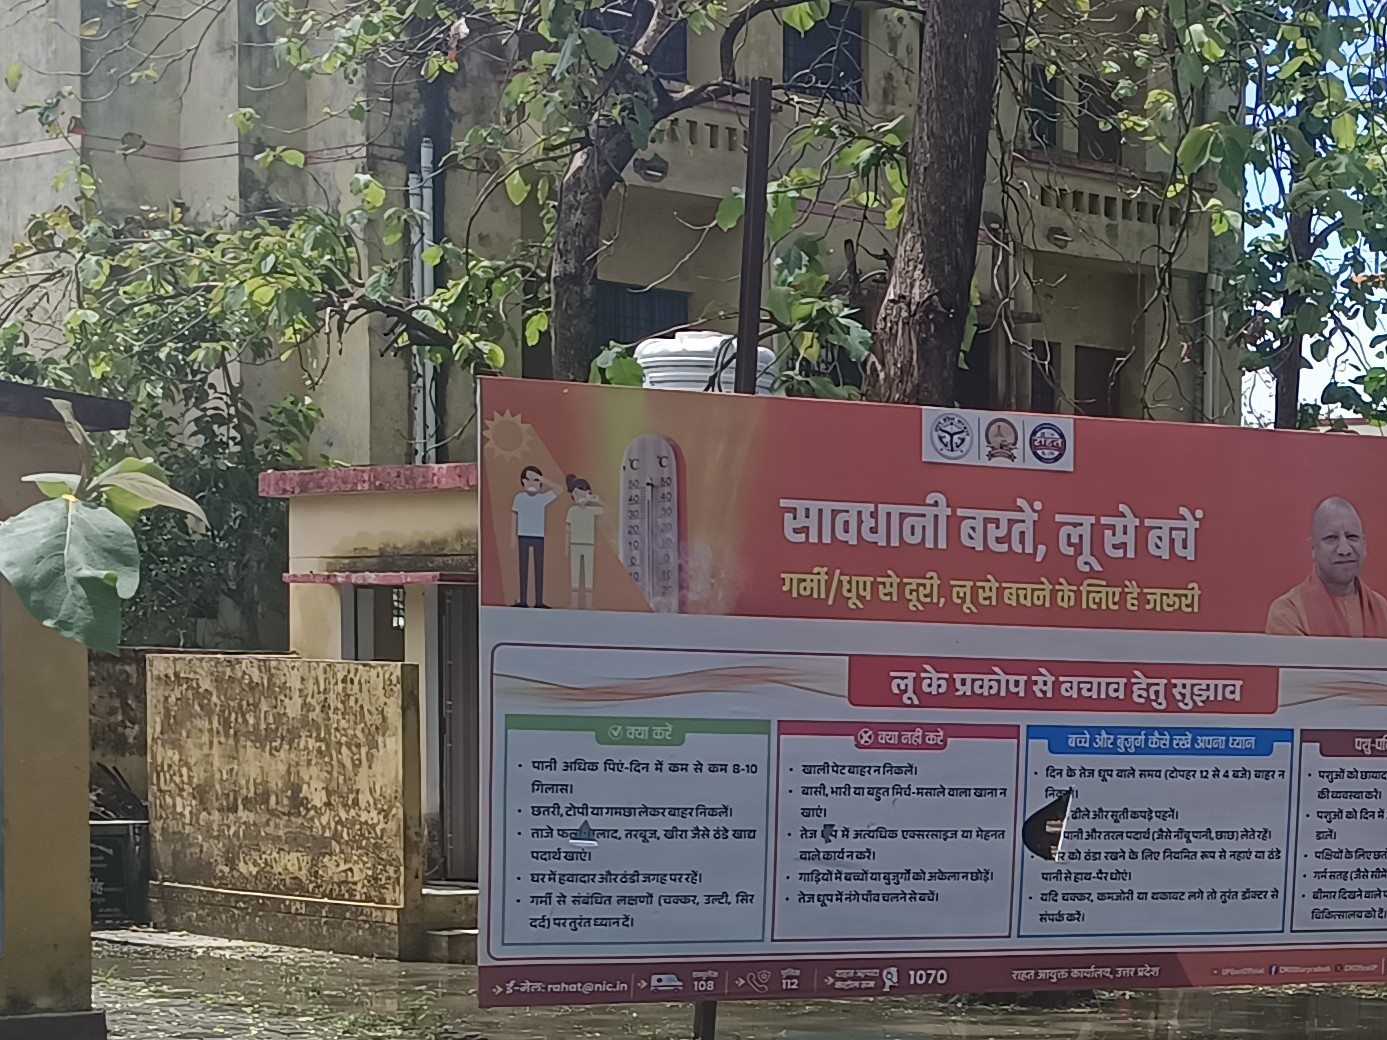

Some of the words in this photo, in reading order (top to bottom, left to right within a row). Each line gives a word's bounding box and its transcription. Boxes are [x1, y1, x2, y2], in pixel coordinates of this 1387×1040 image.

[779, 492, 952, 549] सावधानी
[956, 497, 1047, 562] बरतें,
[1055, 513, 1104, 572] लू
[1100, 503, 1140, 558] से
[1144, 506, 1204, 561] बचें
[781, 566, 874, 609] गर्मी/धूप
[876, 569, 901, 602] से
[902, 571, 946, 611] दूरी,
[949, 580, 978, 614] लू
[976, 574, 1000, 606] से
[1001, 577, 1053, 607] बचने
[1055, 577, 1078, 608] के
[1079, 579, 1123, 610] लिए
[1124, 580, 1141, 612] है
[889, 670, 920, 705] लू
[921, 664, 950, 697] के
[953, 666, 1028, 698] प्रकोप
[1032, 667, 1056, 698] से
[1059, 675, 1128, 700] बचाव
[1130, 670, 1168, 710] हेतु
[1171, 677, 1243, 710] सुझाव
[626, 726, 649, 740] क्या
[878, 731, 899, 744] क्या
[1093, 730, 1115, 748] और
[1194, 736, 1226, 749] अपना
[531, 757, 558, 772] पानी
[562, 758, 600, 772] अधिक
[654, 759, 665, 773] में
[668, 762, 690, 773] कम
[692, 759, 704, 773] से
[707, 763, 729, 774] कम
[732, 763, 758, 774] 8-10
[802, 761, 830, 775] खाली
[831, 761, 847, 775] पेट
[848, 765, 873, 777] बाहर
[531, 779, 574, 794] गिलास।
[530, 802, 563, 818] छतरी,
[565, 802, 590, 817] टोपी
[530, 824, 554, 839] ताजे
[624, 828, 660, 843] तरबूज,
[662, 826, 689, 840] खीरा
[690, 826, 711, 840] जैसे
[712, 826, 730, 840] ठंडे
[800, 826, 818, 839] तेज
[841, 826, 852, 839] में
[853, 826, 898, 839] अत्यधिक
[961, 829, 973, 839] या
[976, 826, 1006, 841] मेहनत
[530, 873, 546, 883] घर
[547, 869, 558, 883] में
[558, 873, 597, 884] हवादार
[597, 869, 619, 883] और
[619, 869, 640, 883] ठंडी
[641, 873, 669, 884] जगह
[669, 873, 684, 883] पर
[530, 892, 553, 905] गर्मी
[556, 892, 567, 905] से
[570, 892, 613, 905] संबंधित
[616, 891, 654, 905] लक्षणों
[703, 891, 731, 905] उल्टी,
[735, 891, 755, 904] सिर
[552, 917, 568, 928] पर
[568, 914, 593, 931] तुरंत
[593, 917, 620, 928] ध्यान
[782, 979, 799, 990] 112
[909, 969, 948, 985] 1070
[547, 981, 628, 995] rahat@nic.in
[693, 980, 715, 991] 108
